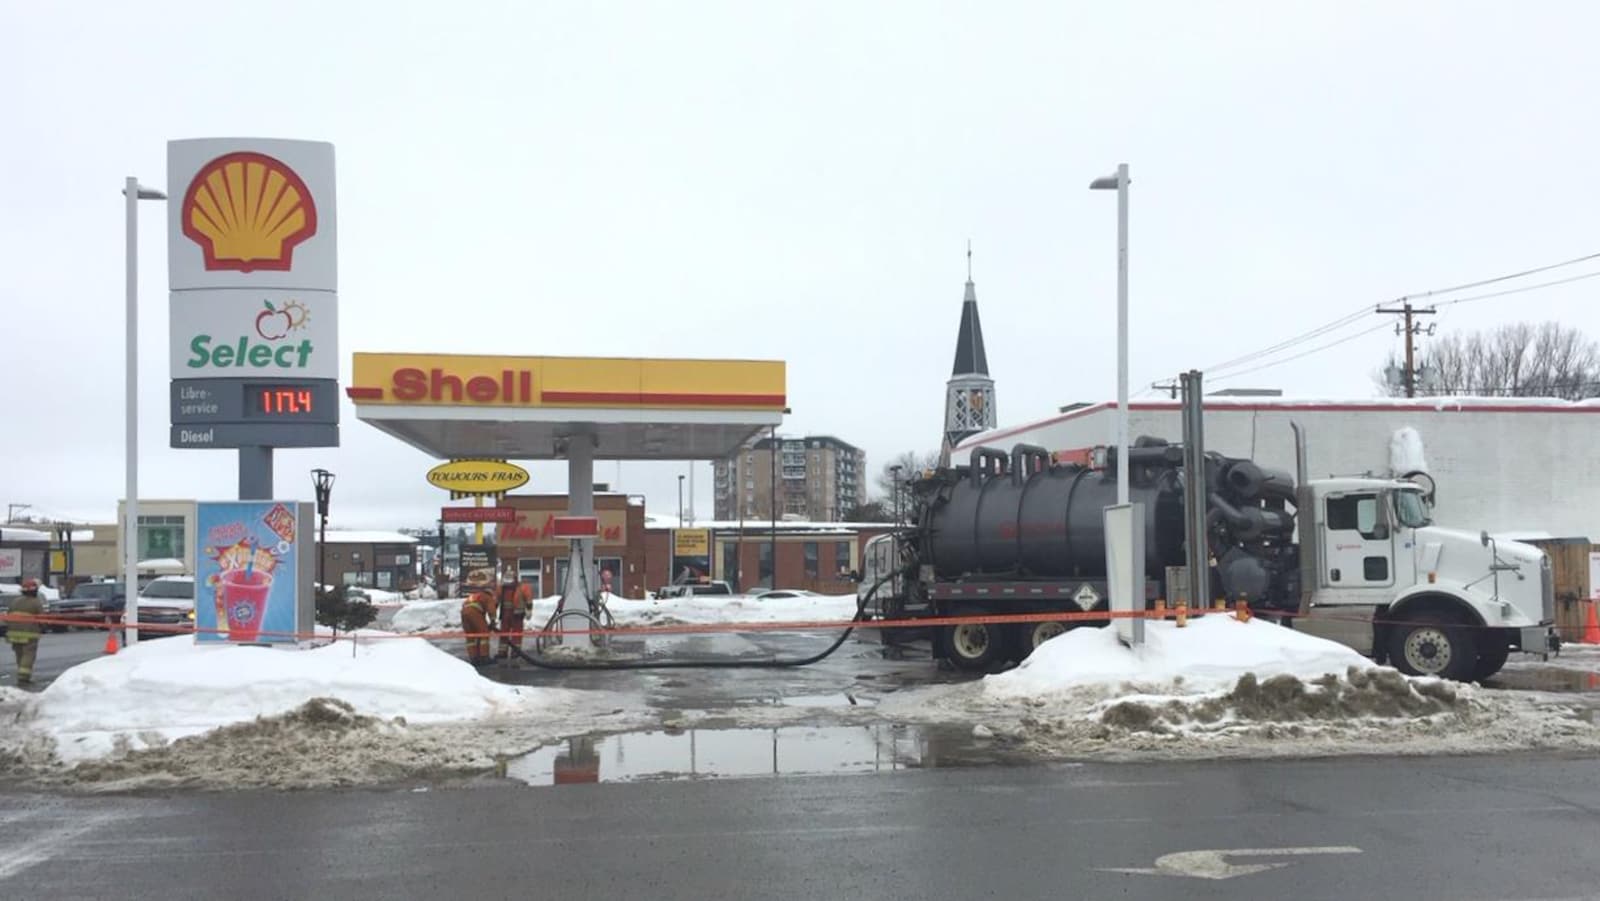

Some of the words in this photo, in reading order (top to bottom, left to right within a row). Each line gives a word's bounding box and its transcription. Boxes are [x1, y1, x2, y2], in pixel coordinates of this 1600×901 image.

[187, 334, 314, 369] Select
[391, 367, 532, 404] Shell
[180, 404, 218, 415] service
[180, 428, 214, 443] Diesel
[431, 471, 489, 481] TOUJOURS
[491, 471, 524, 481] FRAIS
